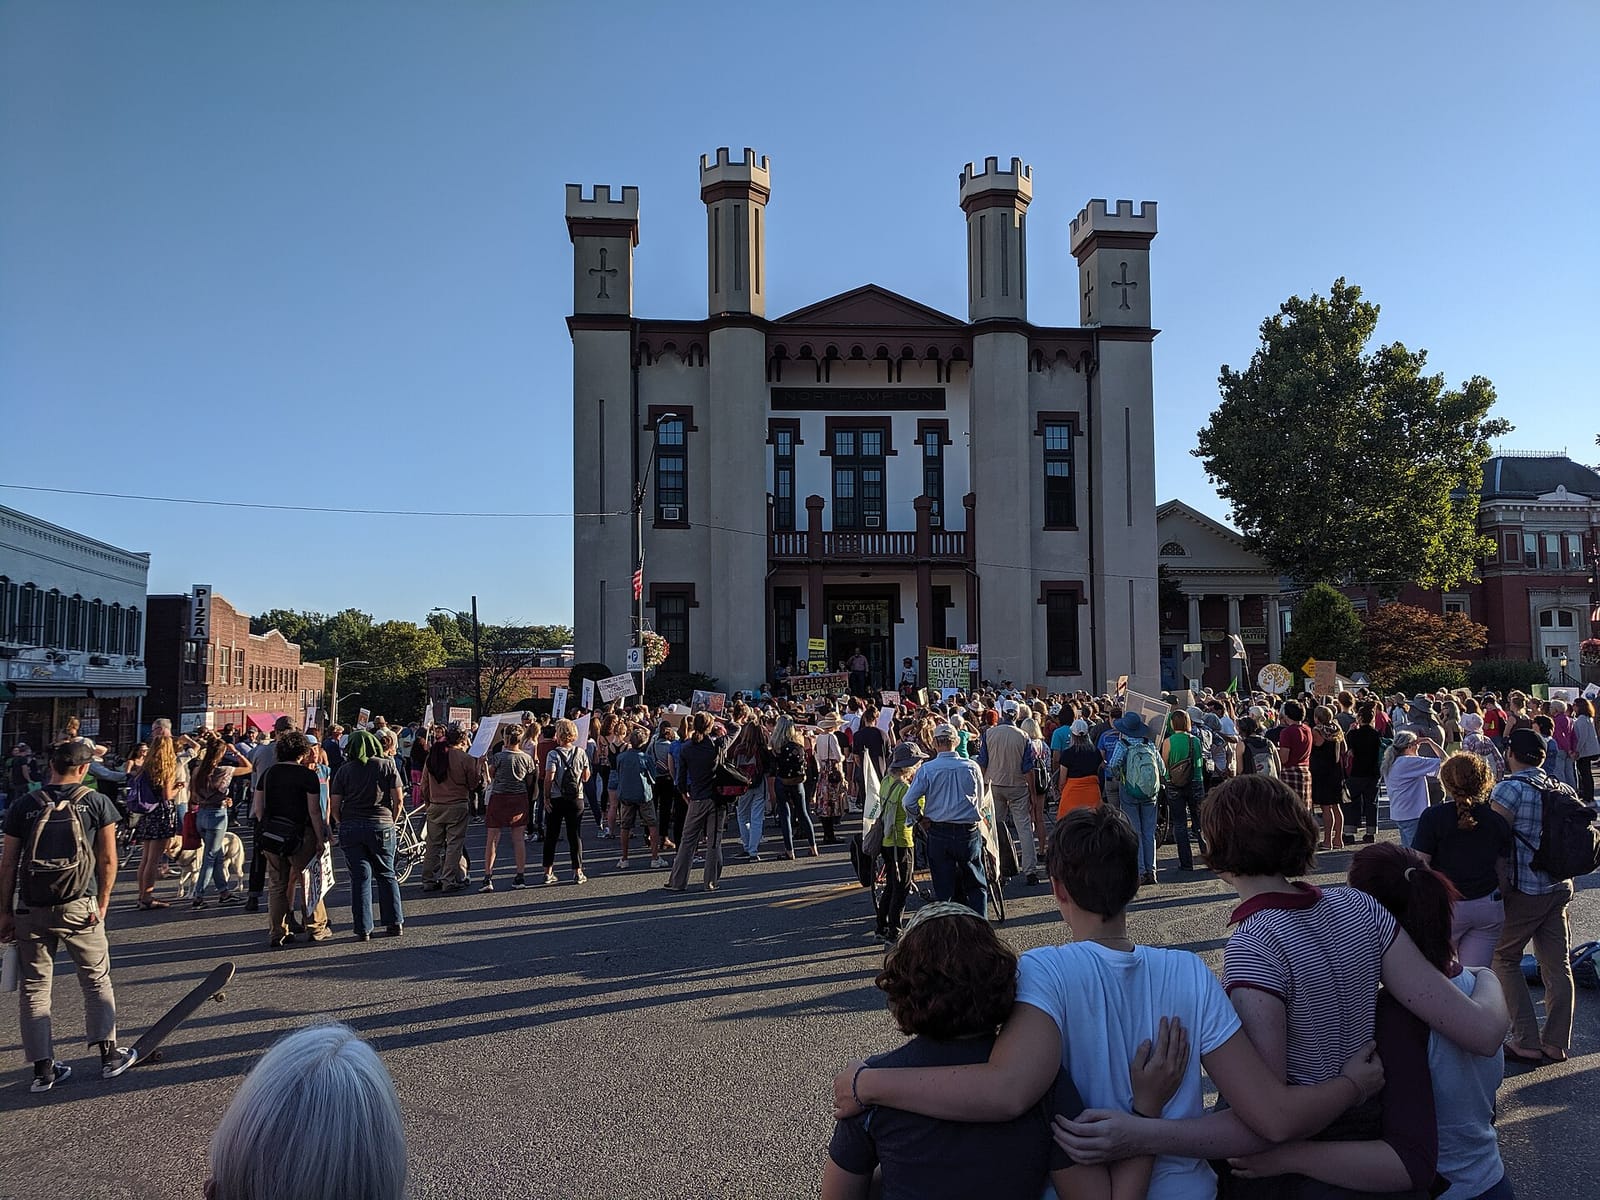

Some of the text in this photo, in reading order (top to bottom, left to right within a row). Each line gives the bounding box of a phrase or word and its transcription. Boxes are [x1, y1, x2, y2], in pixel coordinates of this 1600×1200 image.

[784, 391, 934, 401] NORTHAMPTON
[836, 603, 881, 611] CITY HALL
[194, 588, 207, 637] PIZZA
[931, 657, 964, 668] GREEN
[938, 668, 961, 678] NEW
[798, 676, 841, 685] CLIMATE
[937, 678, 959, 689] DEAL
[793, 681, 847, 691] EMERGENCY
